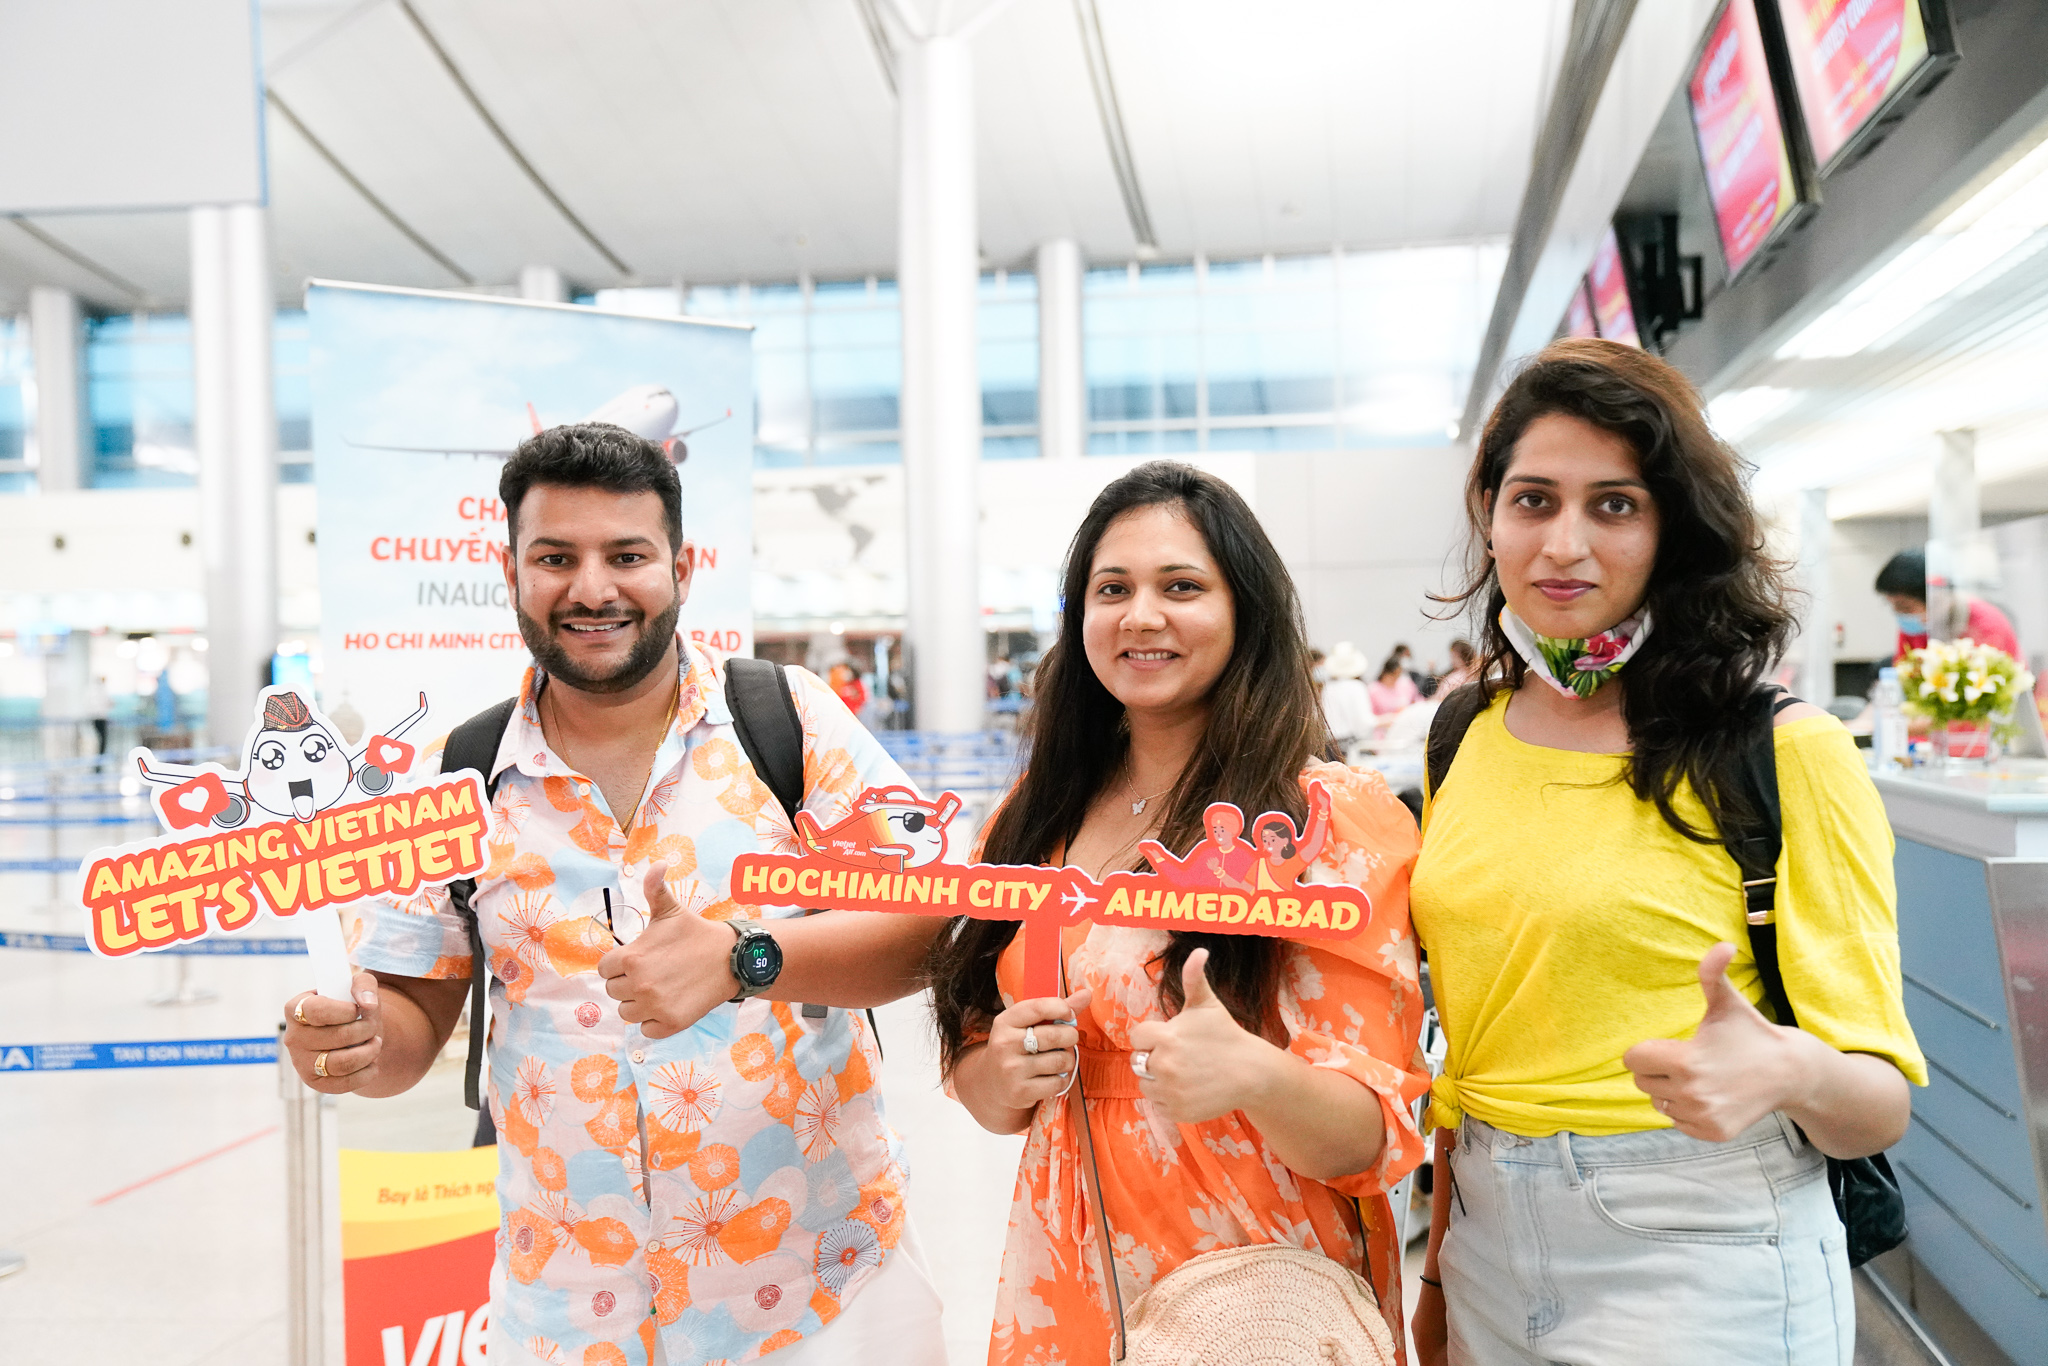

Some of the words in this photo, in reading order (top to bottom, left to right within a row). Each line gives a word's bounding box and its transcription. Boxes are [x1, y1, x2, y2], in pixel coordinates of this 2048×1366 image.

[418, 582, 509, 608] INAUG
[344, 631, 379, 650] HO
[385, 632, 423, 650] CHI
[428, 632, 484, 650] MINH
[90, 828, 290, 900] AMAZING
[293, 785, 476, 850] VIETNAM
[100, 876, 251, 949] LET'S
[259, 820, 481, 909] VIETJET
[742, 865, 960, 905] HOCHIMINH
[968, 879, 1052, 911] CITY
[1104, 887, 1360, 931] AHMEDABAD
[227, 1042, 278, 1059] INTER
